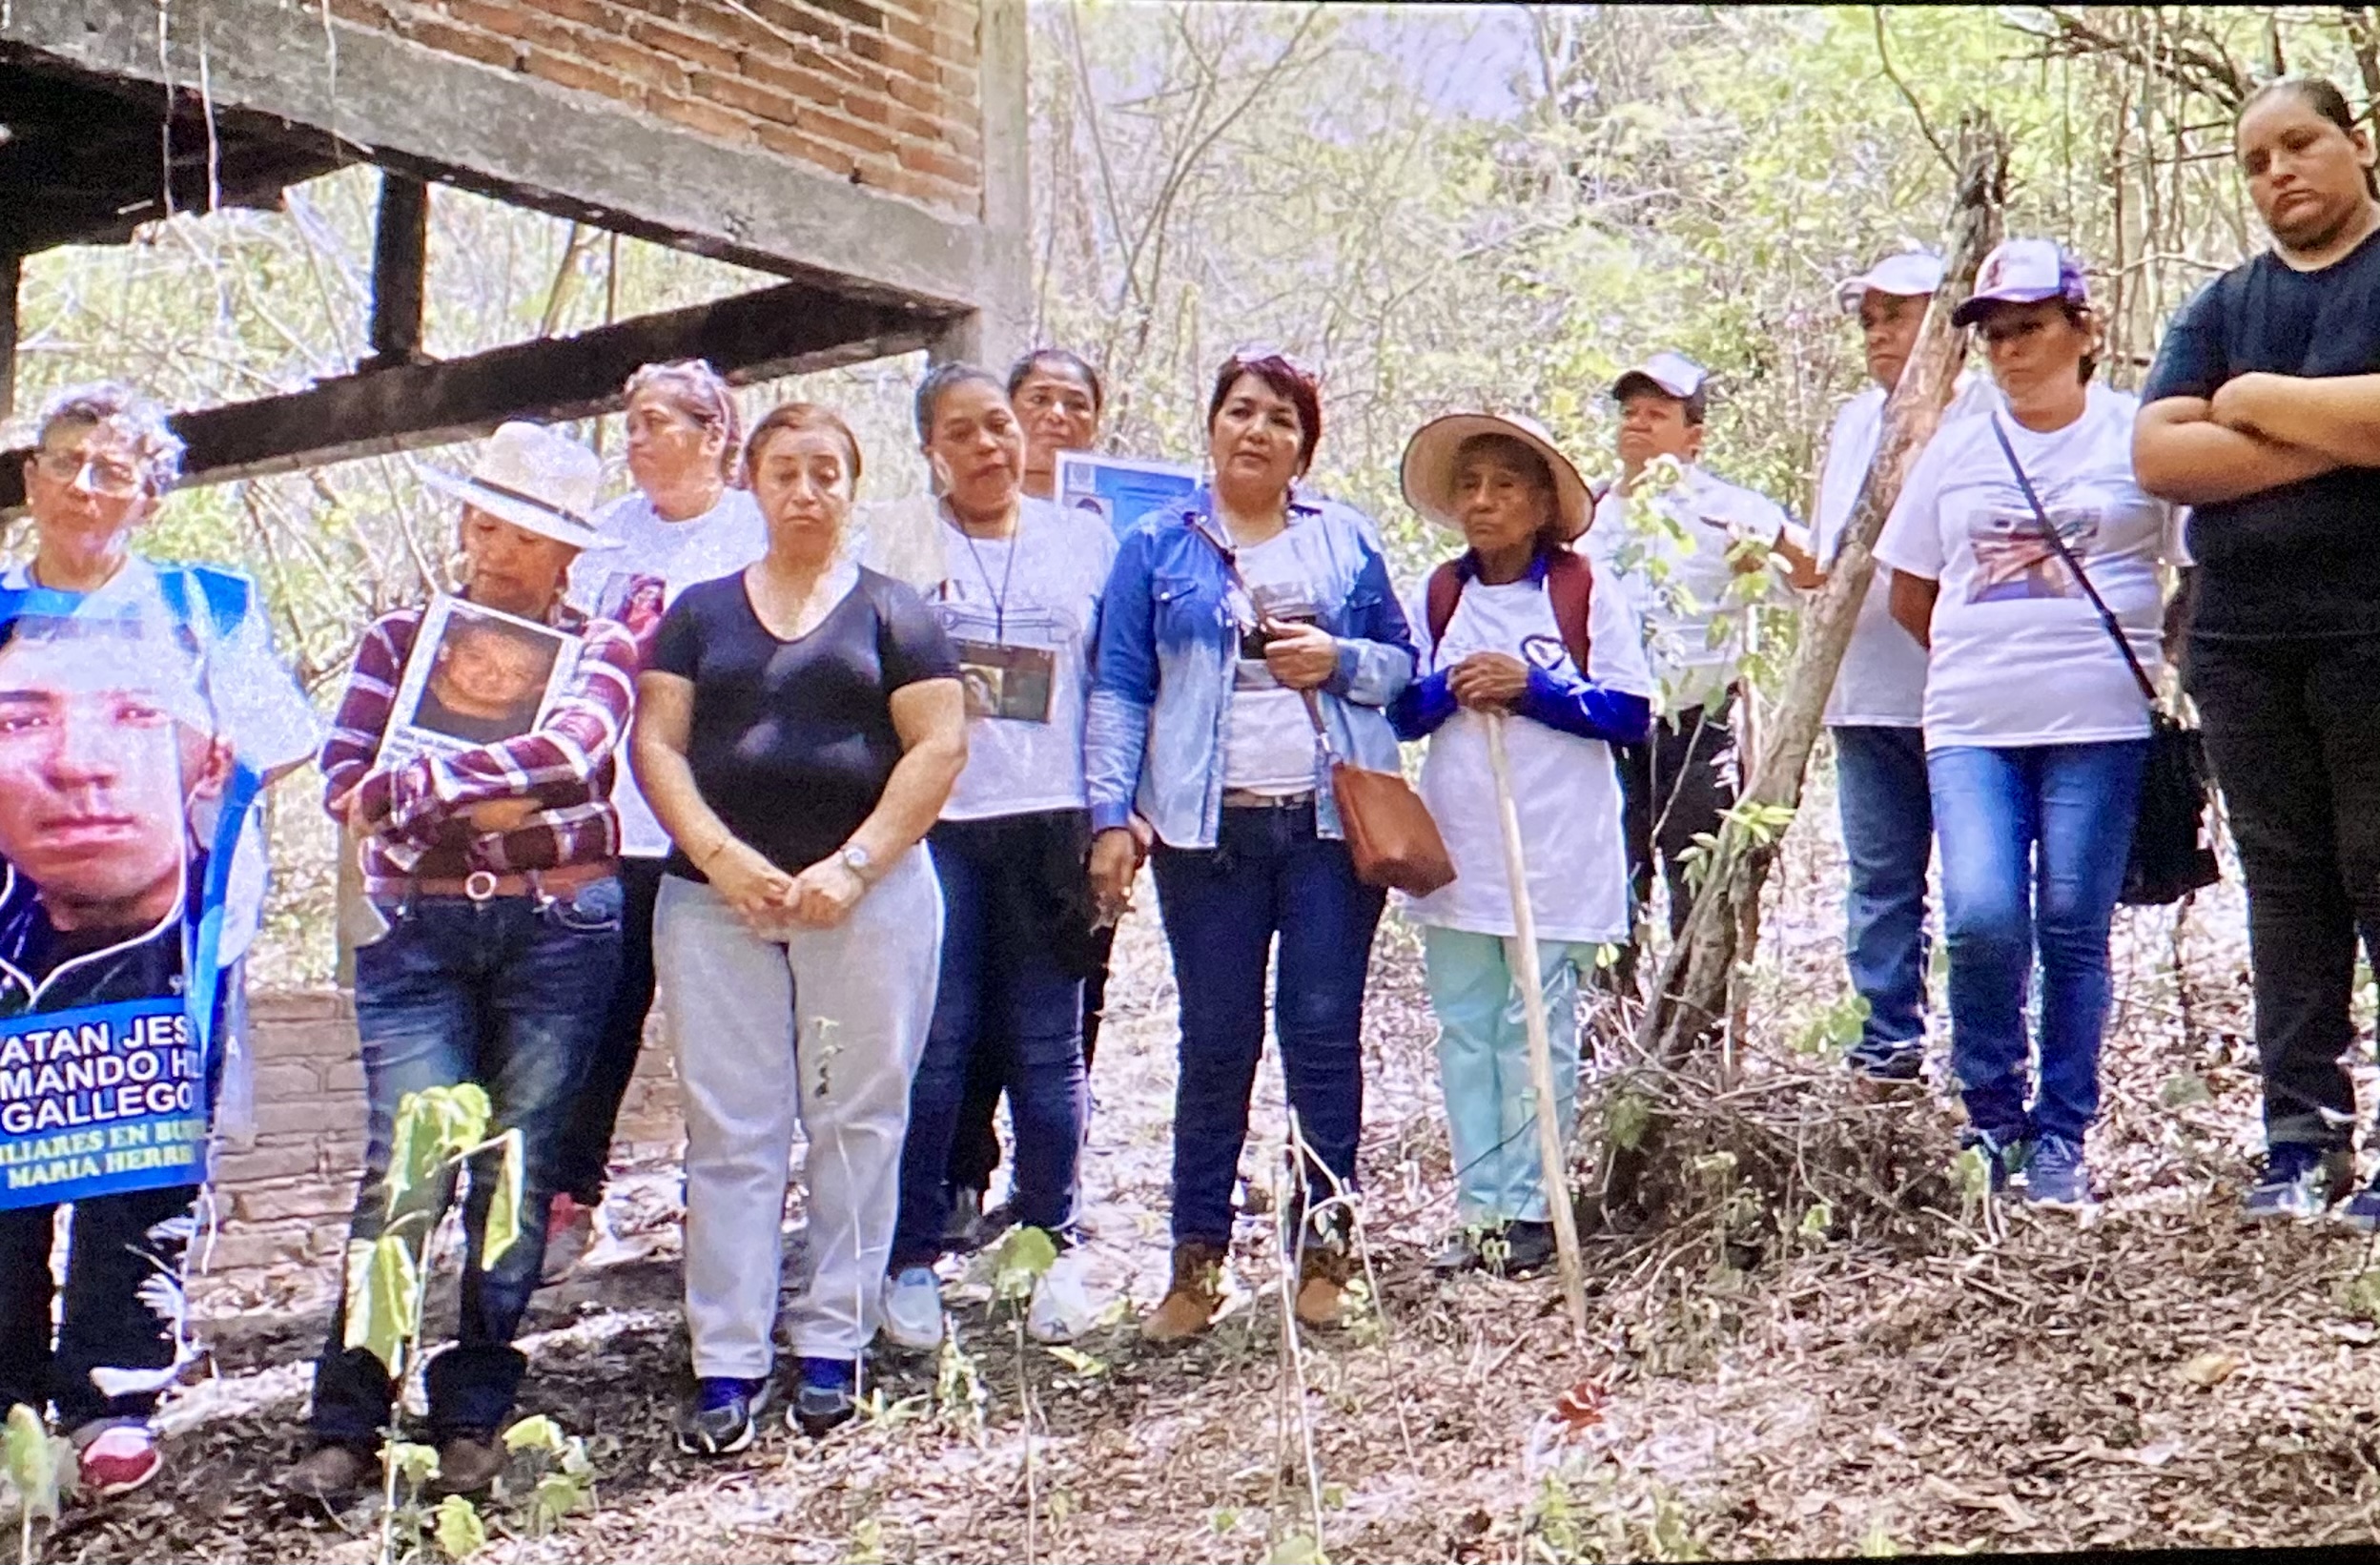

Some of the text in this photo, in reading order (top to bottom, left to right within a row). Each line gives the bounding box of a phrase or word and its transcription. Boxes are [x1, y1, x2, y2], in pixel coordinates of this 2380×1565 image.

[0, 1022, 111, 1067] ATAN
[0, 1051, 159, 1100] MANDO
[1, 1081, 193, 1133] GALLEGO
[110, 1122, 149, 1148] EN
[8, 1155, 101, 1190] MARIA
